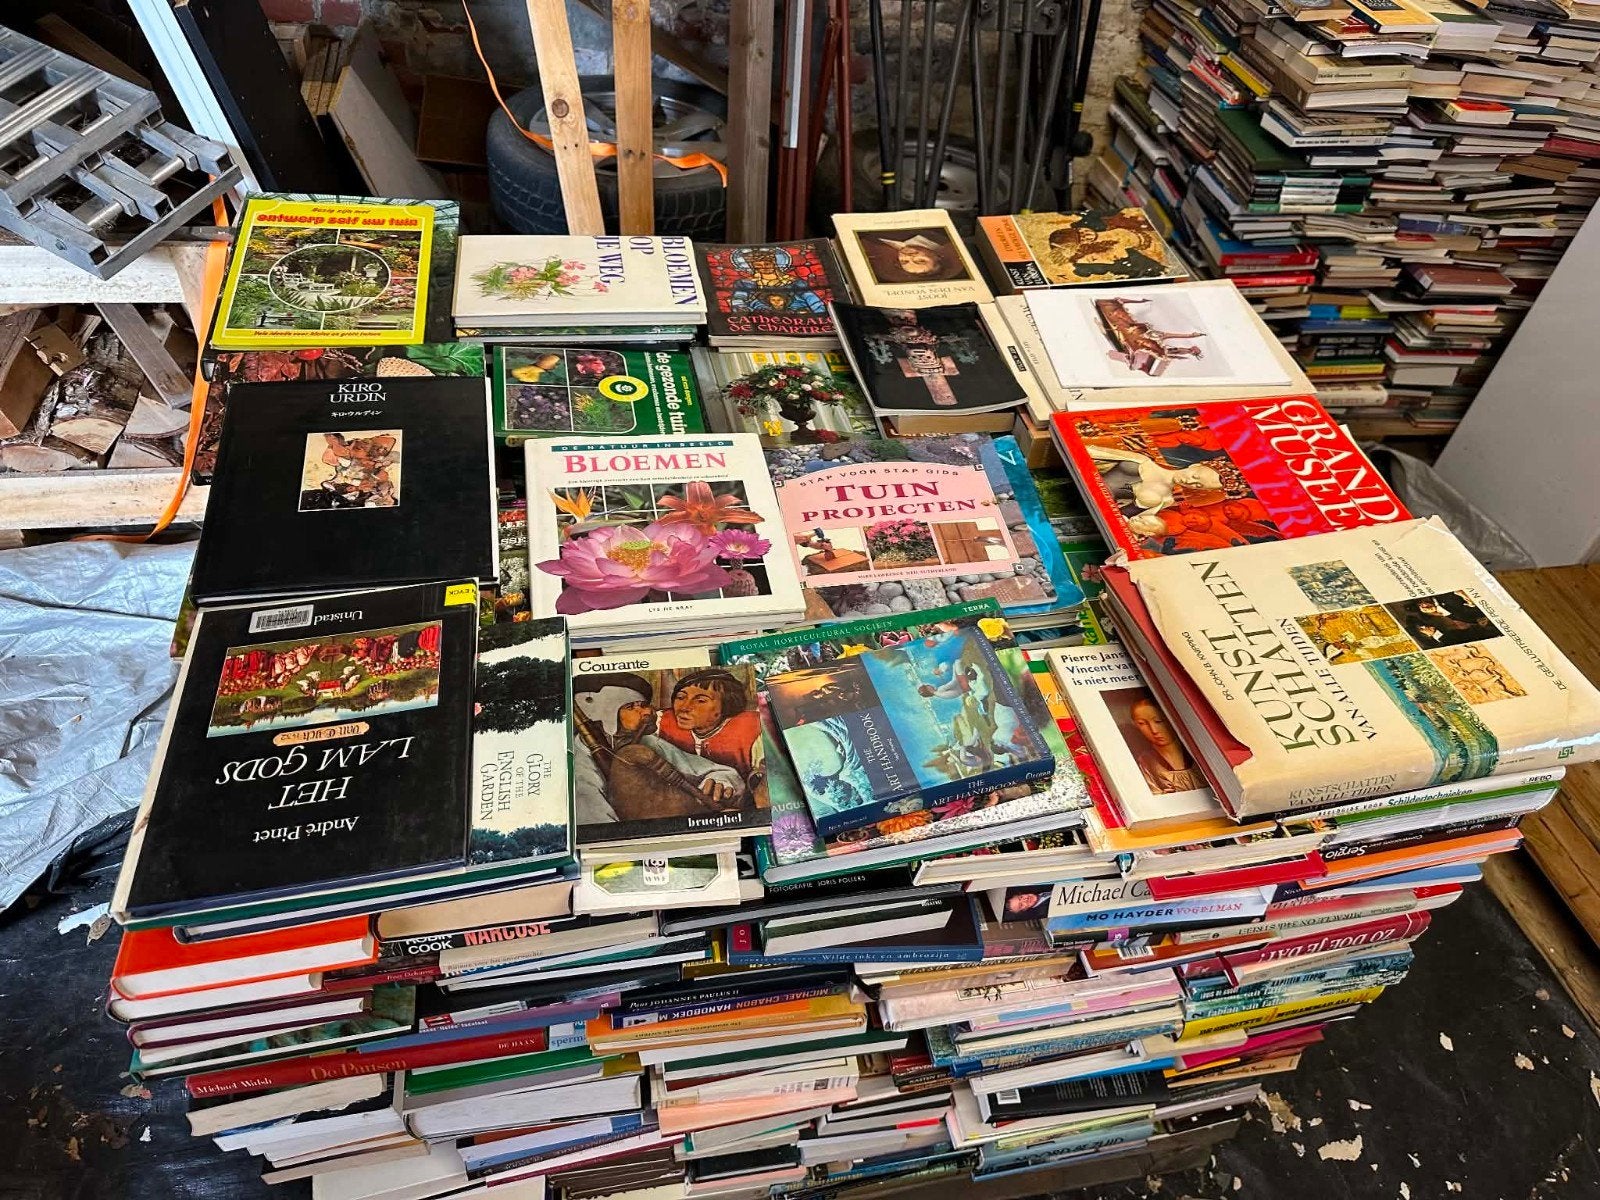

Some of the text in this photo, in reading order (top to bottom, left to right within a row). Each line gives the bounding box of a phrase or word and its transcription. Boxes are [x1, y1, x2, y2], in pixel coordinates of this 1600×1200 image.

[361, 218, 386, 226] uw
[389, 218, 419, 227] tuin
[629, 236, 655, 255] OP
[598, 253, 625, 284] WEG
[661, 237, 699, 305] BLOEMEN
[730, 324, 752, 332] DE
[655, 352, 671, 364] de
[329, 392, 387, 403] URDIN
[338, 383, 382, 393] KIRO
[655, 365, 683, 410] gezonde
[564, 452, 728, 474] BLOEMEN
[1243, 403, 1366, 532] MUSEE
[1280, 400, 1400, 522] GRAND
[799, 474, 834, 487] STAP
[839, 468, 877, 478] VOOR
[925, 468, 960, 476] GIDS
[825, 481, 942, 502] TUIN
[802, 498, 976, 523] PROJECTEN
[962, 602, 991, 613] TERRA
[313, 610, 363, 627] Unistad
[740, 619, 896, 652] ROYAL HORTICULTURAL SOCIETY
[1478, 598, 1567, 692] DE PERS
[1061, 654, 1097, 664] Pierre
[1188, 560, 1360, 747] SCHATTEN
[578, 660, 650, 673] Courante
[1066, 661, 1135, 675] Vincent van
[1073, 674, 1140, 686] is niet meer
[1206, 667, 1225, 690] JOHN
[1275, 617, 1377, 741] VAN ALLE TIJDEN
[1199, 628, 1321, 754] KUNST
[860, 712, 894, 773] HANDBOOK
[316, 736, 416, 772] LAM
[864, 748, 876, 763] THE
[525, 753, 543, 797] GLORY
[543, 760, 552, 779] THE
[497, 750, 515, 812] ENGLISH
[515, 766, 524, 799] OF THE
[886, 772, 904, 792] ART
[968, 779, 984, 790] THE
[1288, 773, 1397, 801] KUNSTSCHATTEN
[267, 776, 353, 811] HET
[480, 762, 498, 821] GARDEN
[931, 780, 1017, 807] ART HANDBOOK
[1387, 788, 1474, 807] Schildertechnieken
[771, 802, 806, 813] AUGUS
[252, 815, 360, 843] André Pinet
[688, 812, 743, 829] brueghel
[1325, 844, 1366, 860] Sergio
[769, 882, 813, 893] FOTOGRAFIE
[838, 875, 866, 885] POLLERS
[1057, 880, 1126, 906] Michael
[1086, 902, 1242, 922] MO HAYDER VOGELMAN
[1301, 917, 1318, 927] ON
[1319, 911, 1362, 926] MIRACLE
[463, 922, 551, 946] NARCOSE
[1238, 923, 1276, 936] STREET
[1306, 928, 1396, 951] ZO DOE JE
[408, 941, 453, 955] COOK
[822, 952, 851, 961] Wilde
[649, 995, 697, 1007] JOHANNES
[699, 991, 730, 999] PAULUS
[672, 987, 829, 1020] MICHAEL CHABON HANDBOEK
[1242, 1003, 1260, 1014] van
[498, 1038, 536, 1050] DE HAAN
[551, 1033, 588, 1049] sperm
[197, 1066, 337, 1095] Michael Walsh De
